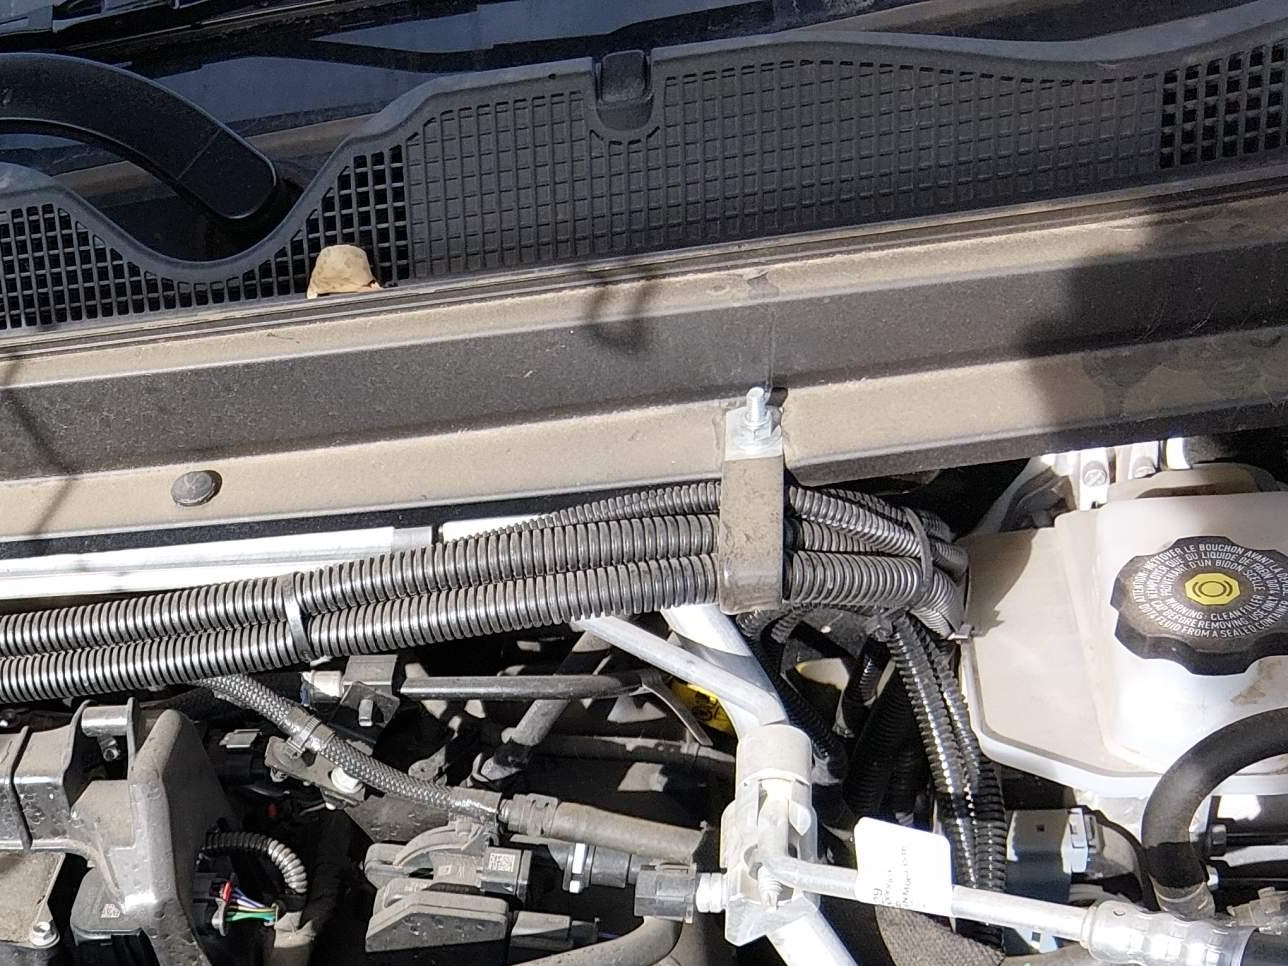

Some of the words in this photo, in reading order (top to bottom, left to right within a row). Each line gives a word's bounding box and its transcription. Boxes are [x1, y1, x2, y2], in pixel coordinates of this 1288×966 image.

[1144, 547, 1183, 571] NETTOYER
[1184, 544, 1197, 553] LE
[1199, 543, 1245, 555] BOUCHON
[1244, 550, 1275, 566] AVANT
[1269, 563, 1284, 574] LA
[1166, 557, 1185, 568] QUE
[1186, 552, 1199, 562] DU
[1201, 551, 1239, 562] LIQUIDE
[1239, 555, 1254, 566] DE
[1251, 562, 1274, 580] FREIN
[1190, 560, 1212, 569] D'UN
[1215, 559, 1245, 572] BIDON
[1151, 600, 1169, 612] CAP
[1163, 608, 1198, 628] BEFORE
[1249, 609, 1269, 621] USE
[1261, 594, 1281, 612] ONLY
[1164, 597, 1208, 620] WARNING:
[1210, 608, 1244, 621] CLEAN
[1240, 594, 1265, 614] FILLER
[1155, 615, 1182, 632] FLUID
[1181, 625, 1211, 638] FROM
[1211, 630, 1219, 638] A
[1219, 624, 1257, 638] SEALED
